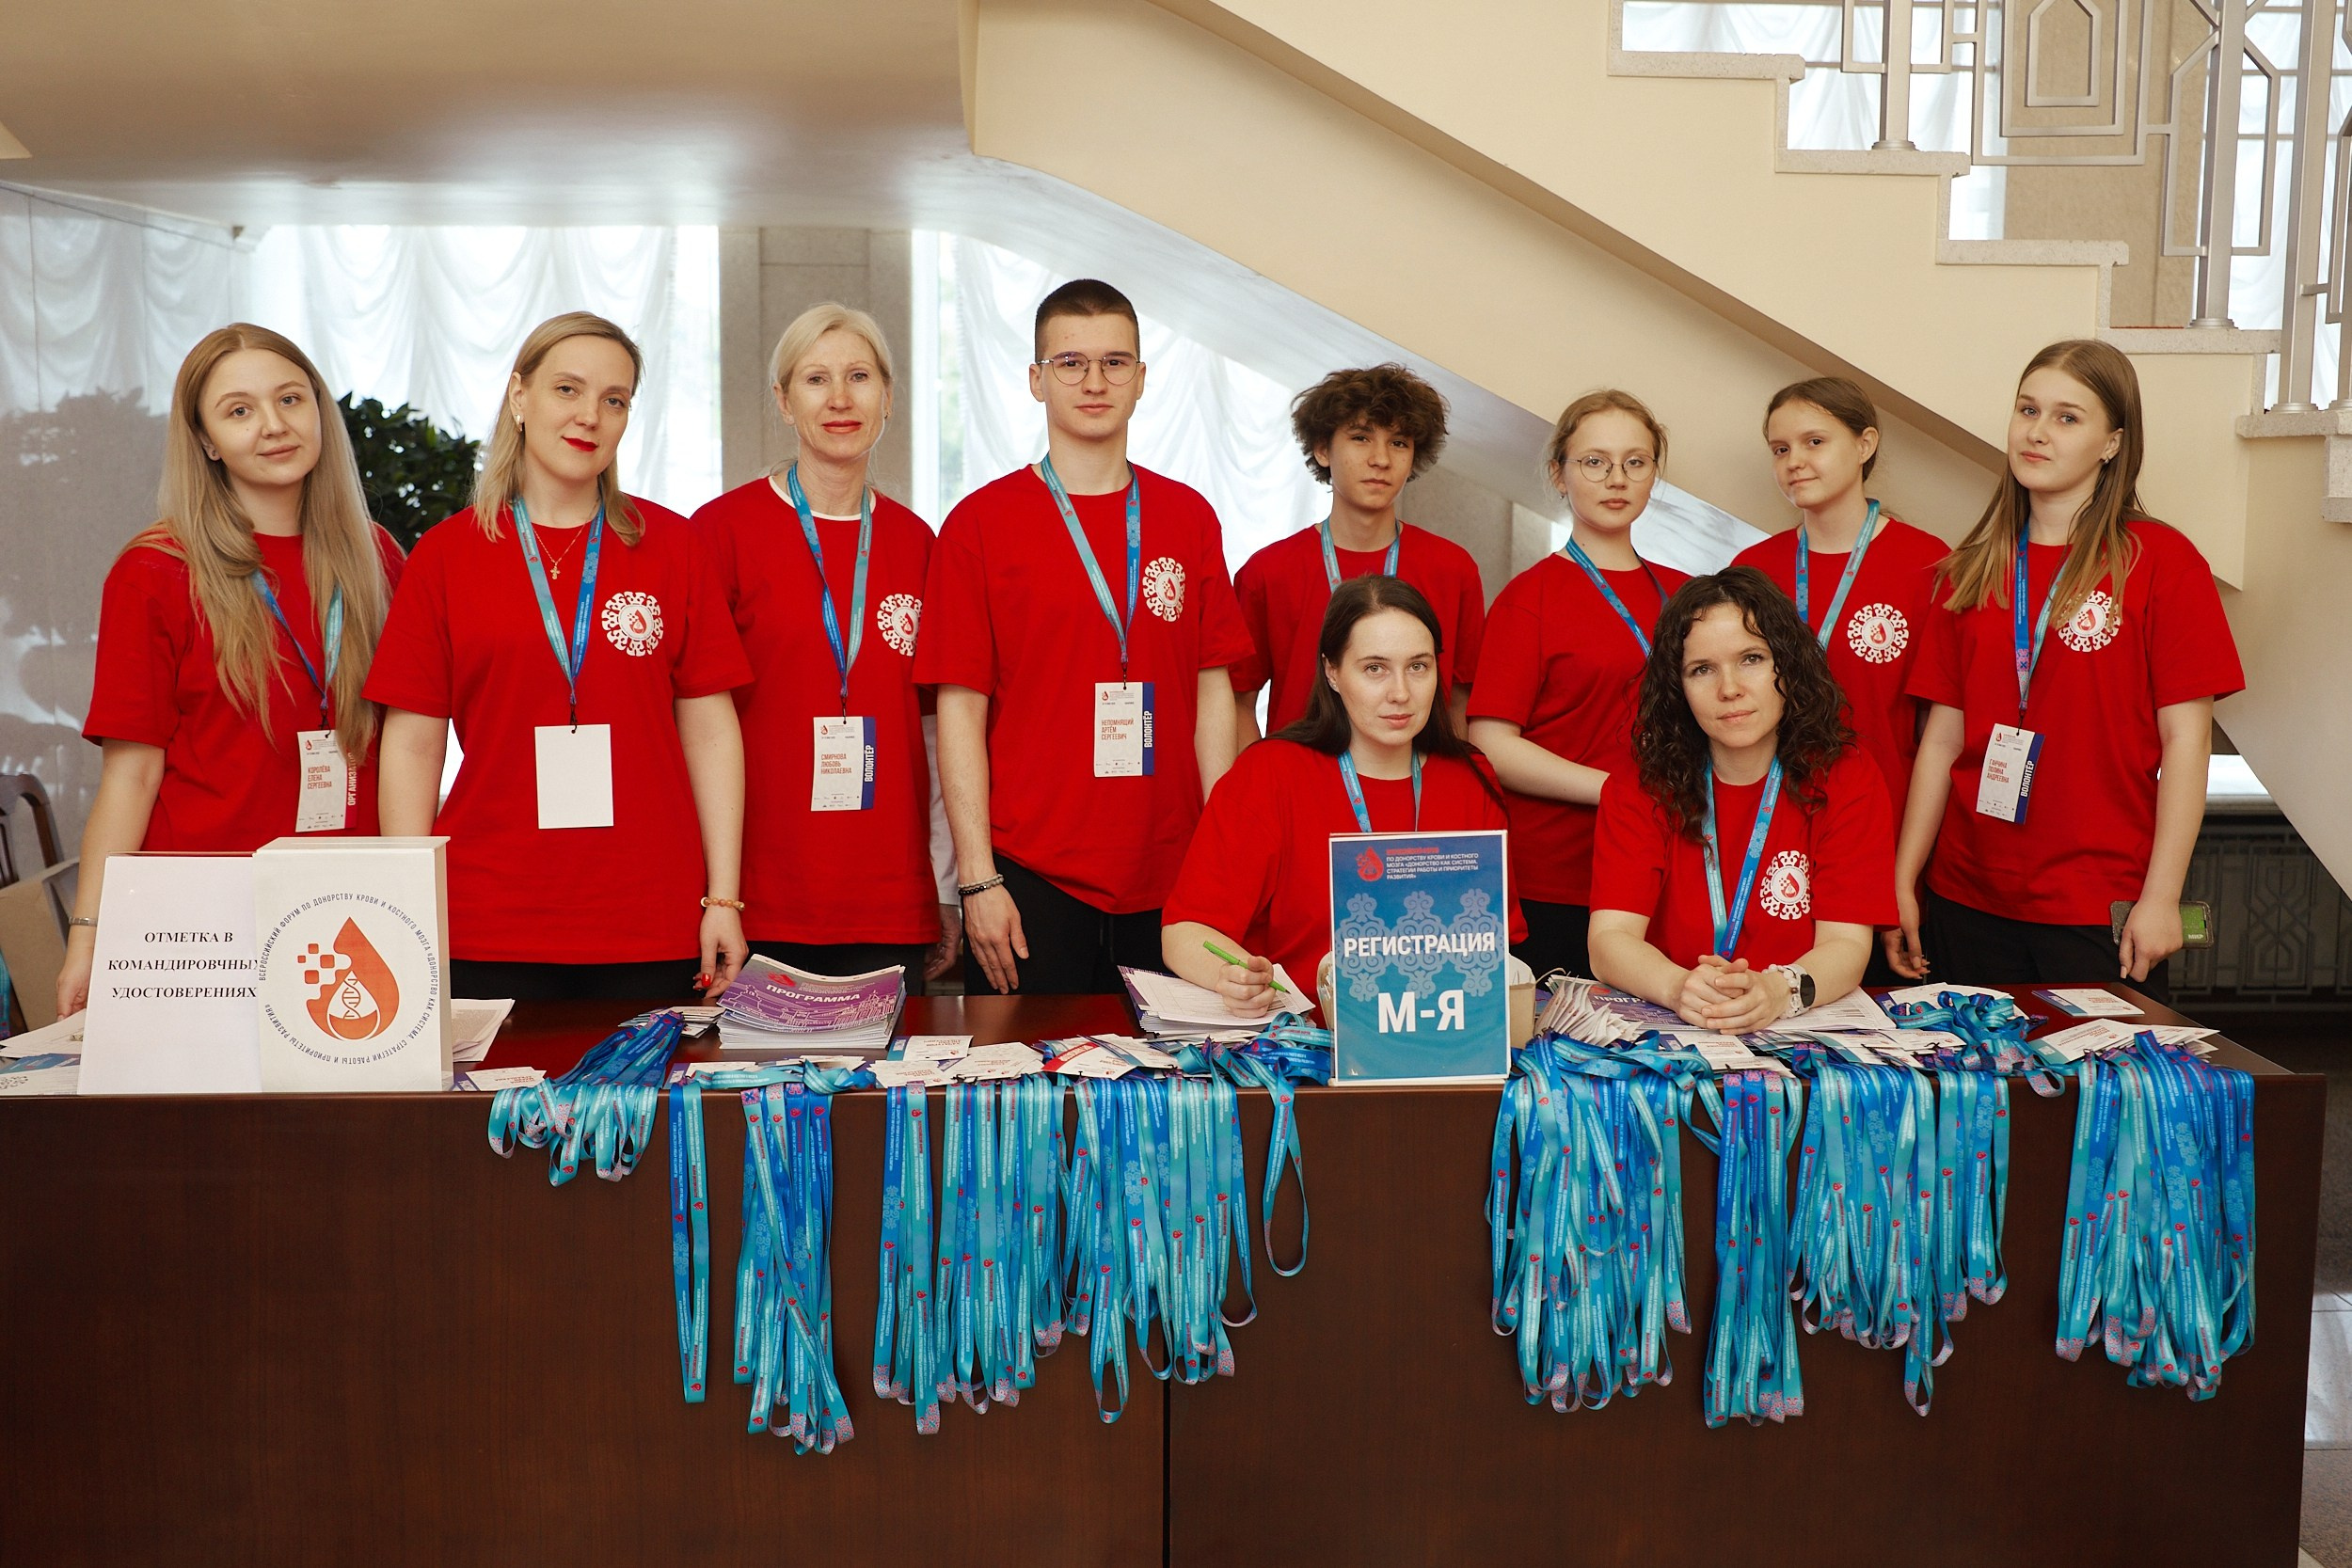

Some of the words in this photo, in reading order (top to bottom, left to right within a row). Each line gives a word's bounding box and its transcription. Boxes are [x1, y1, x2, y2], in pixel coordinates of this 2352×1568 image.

[1143, 711, 1152, 748] ВОЛОНТЁР
[820, 767, 852, 775] НИКОЛАЕВНА
[865, 745, 874, 783] ВОЛОНТЁР
[307, 781, 332, 790] СЕРГЕЕВНА
[2020, 760, 2035, 798] ВОЛОНТЁР
[301, 901, 311, 911] ПО
[312, 893, 354, 907] ДОНОРСТВУ
[356, 894, 379, 905] КРОВИ
[279, 908, 301, 927] ФОРУМ
[387, 904, 417, 930] КОСТНОГО
[144, 931, 219, 943] ОТМЕТКА
[223, 931, 234, 943] В
[415, 929, 431, 952] МОЗГА
[1343, 932, 1495, 958] РЕГИСТРАЦИЯ
[259, 927, 281, 981] ВСЕРОССИЙСКИЙ
[112, 987, 258, 1000] УДОСТОВЕРЕНИЯХ
[766, 984, 861, 1003] ПРОГРАММА
[1594, 995, 1645, 1004] ПРОГР
[425, 997, 436, 1011] КАК
[1377, 990, 1465, 1034] М-Я
[289, 1037, 331, 1062] ПРИОРИТЕТЫ
[372, 1039, 407, 1062] СТРАТЕГИИ
[342, 1056, 371, 1065] РАБОТЫ
